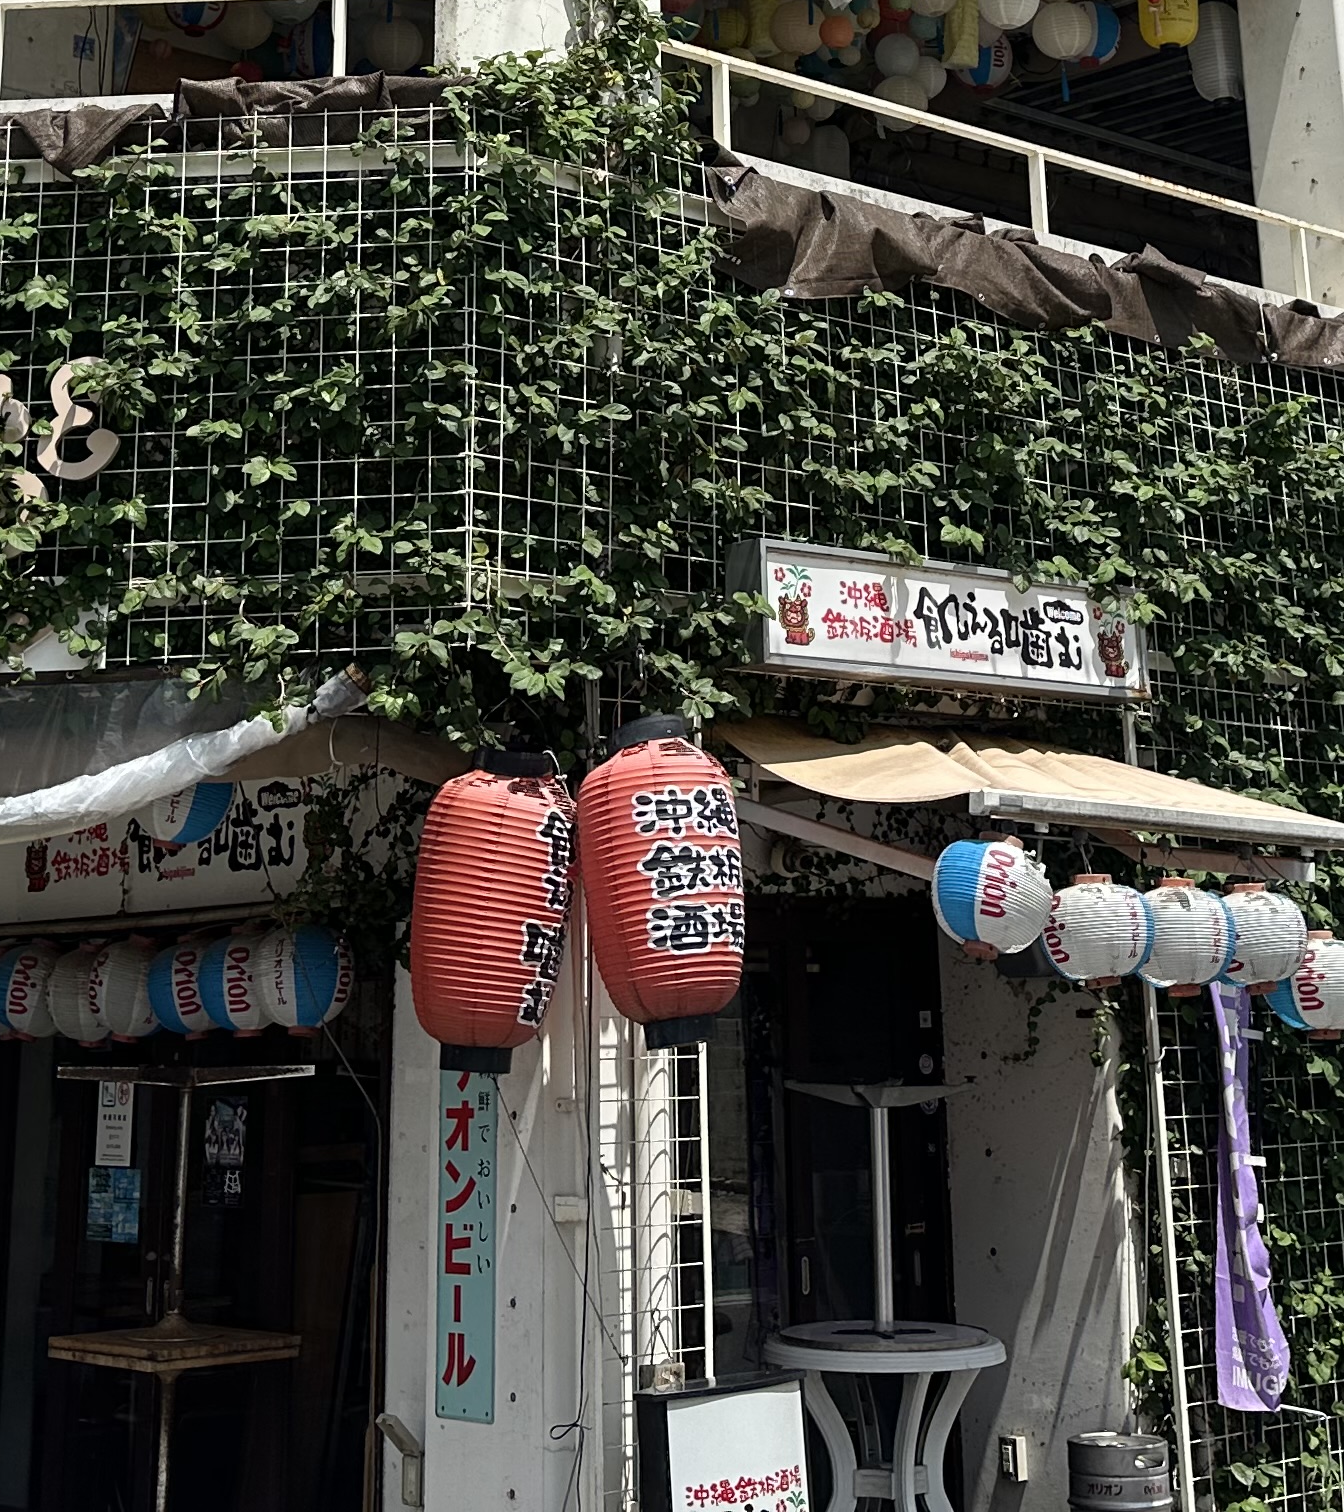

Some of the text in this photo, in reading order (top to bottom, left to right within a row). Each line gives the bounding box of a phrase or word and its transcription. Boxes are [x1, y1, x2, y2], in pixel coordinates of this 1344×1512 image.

[839, 580, 890, 613] 沖縄
[821, 607, 918, 648] 鉄板酒場
[631, 784, 739, 839] 沖縄
[637, 840, 744, 902] 鉄板
[978, 848, 1018, 919] Orion
[646, 898, 746, 955] 酒場
[8, 955, 39, 1016] Orion
[174, 949, 204, 1017] Orion
[226, 946, 254, 1015] Orion
[1087, 1483, 1123, 1496] オリオン
